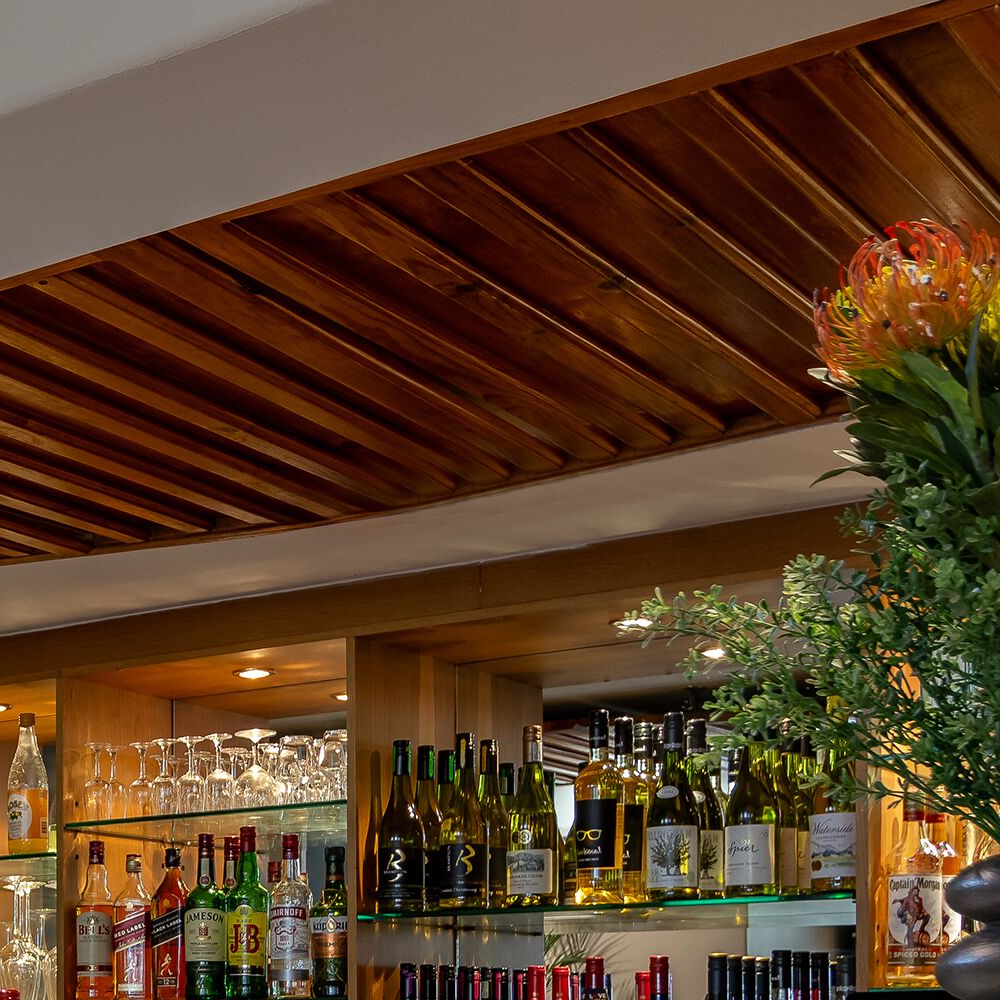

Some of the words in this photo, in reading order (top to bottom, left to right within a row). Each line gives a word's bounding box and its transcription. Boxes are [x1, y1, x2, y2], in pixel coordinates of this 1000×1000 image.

[812, 818, 855, 836] Waterside
[727, 839, 760, 857] Spier
[889, 878, 914, 892] Captain
[152, 925, 166, 935] LACK
[166, 918, 182, 928] LABEL
[185, 911, 225, 925] JAMESON
[78, 923, 110, 936] BELL'S
[113, 929, 126, 939] RED
[126, 922, 146, 934] LABEL
[229, 923, 261, 954] J&B
